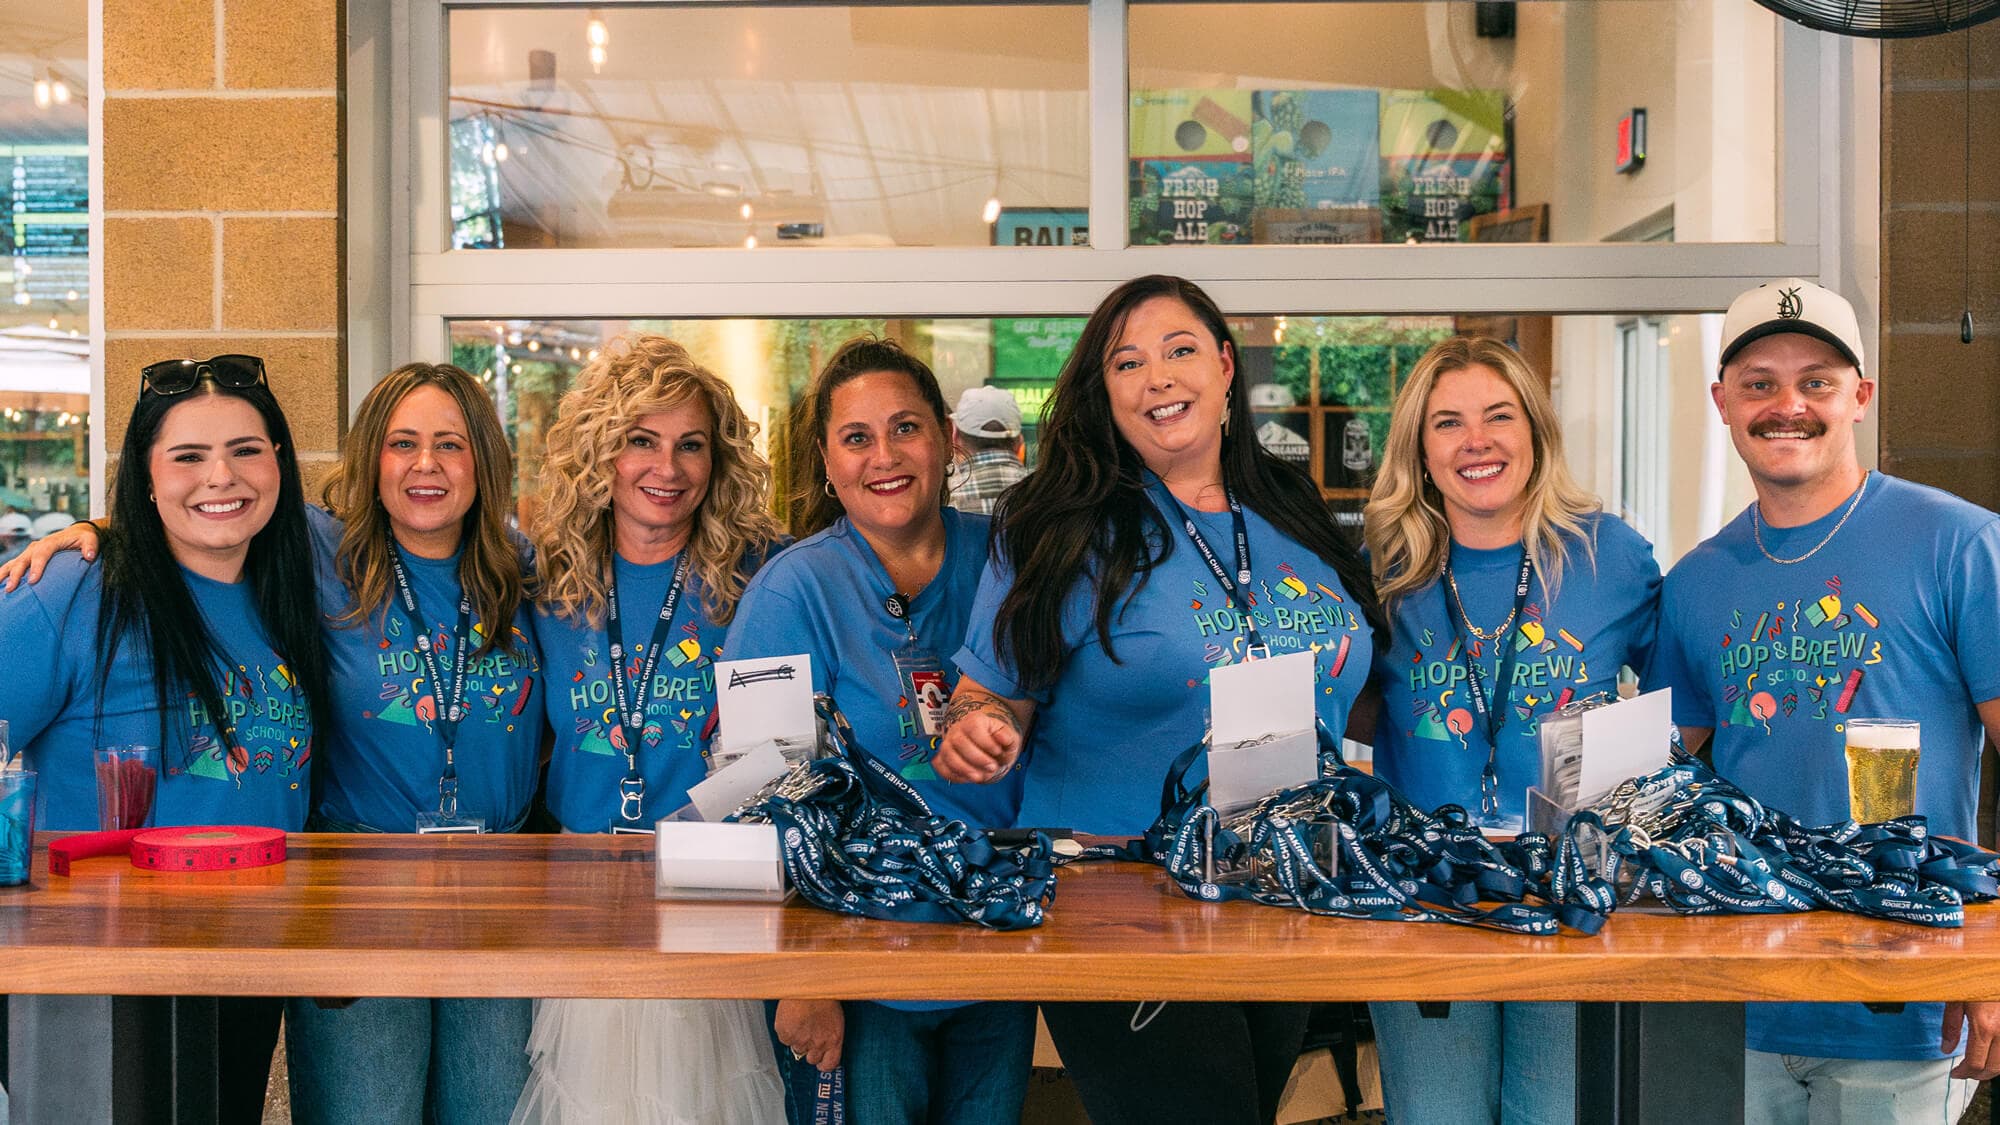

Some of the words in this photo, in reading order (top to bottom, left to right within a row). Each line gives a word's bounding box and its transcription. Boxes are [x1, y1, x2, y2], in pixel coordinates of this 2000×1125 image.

[1162, 178, 1219, 197] FRESH
[1413, 177, 1470, 195] FRESH
[1173, 200, 1208, 219] HOP
[1424, 198, 1459, 217] HOP
[1174, 222, 1209, 240] ALE
[1424, 220, 1458, 239] ALE
[1195, 534, 1213, 559] YAKIMA
[1209, 558, 1226, 577] CHIEF
[1521, 567, 1529, 583] HOP
[668, 588, 677, 607] HOP
[1194, 608, 1250, 637] HOP
[1253, 611, 1272, 627] &
[1274, 605, 1346, 635] BREW
[1262, 635, 1305, 649] CHOOL
[1720, 643, 1770, 679] HOP
[1772, 641, 1789, 660] &
[1791, 632, 1867, 667] BREW
[425, 652, 438, 681] YAKIMA
[434, 681, 443, 705] CHIEF
[615, 660, 624, 689] YAKIMA
[636, 681, 647, 711] YAKIMA
[643, 656, 654, 681] CHIEF
[1410, 661, 1468, 692] HOP
[1469, 674, 1480, 696] CHIEF
[1767, 669, 1812, 686] SCHOOL
[453, 674, 464, 704] YAKIMA
[618, 689, 627, 712] CHIEF
[245, 726, 287, 742] SCHOOL
[884, 769, 908, 791] CHIEF
[794, 814, 818, 839] CHIEF
[1177, 824, 1191, 855] CHIEF
[1285, 827, 1309, 863] YAKIMA
[1350, 841, 1373, 871] YAKIMA
[1367, 866, 1390, 888] CHIEF
[1781, 867, 1812, 889] SCHOOL
[1352, 897, 1394, 906] YAKIMA
[1703, 885, 1740, 906] YAKIMA
[1741, 898, 1766, 907] CHIEF
[1906, 912, 1934, 922] CHIEF
